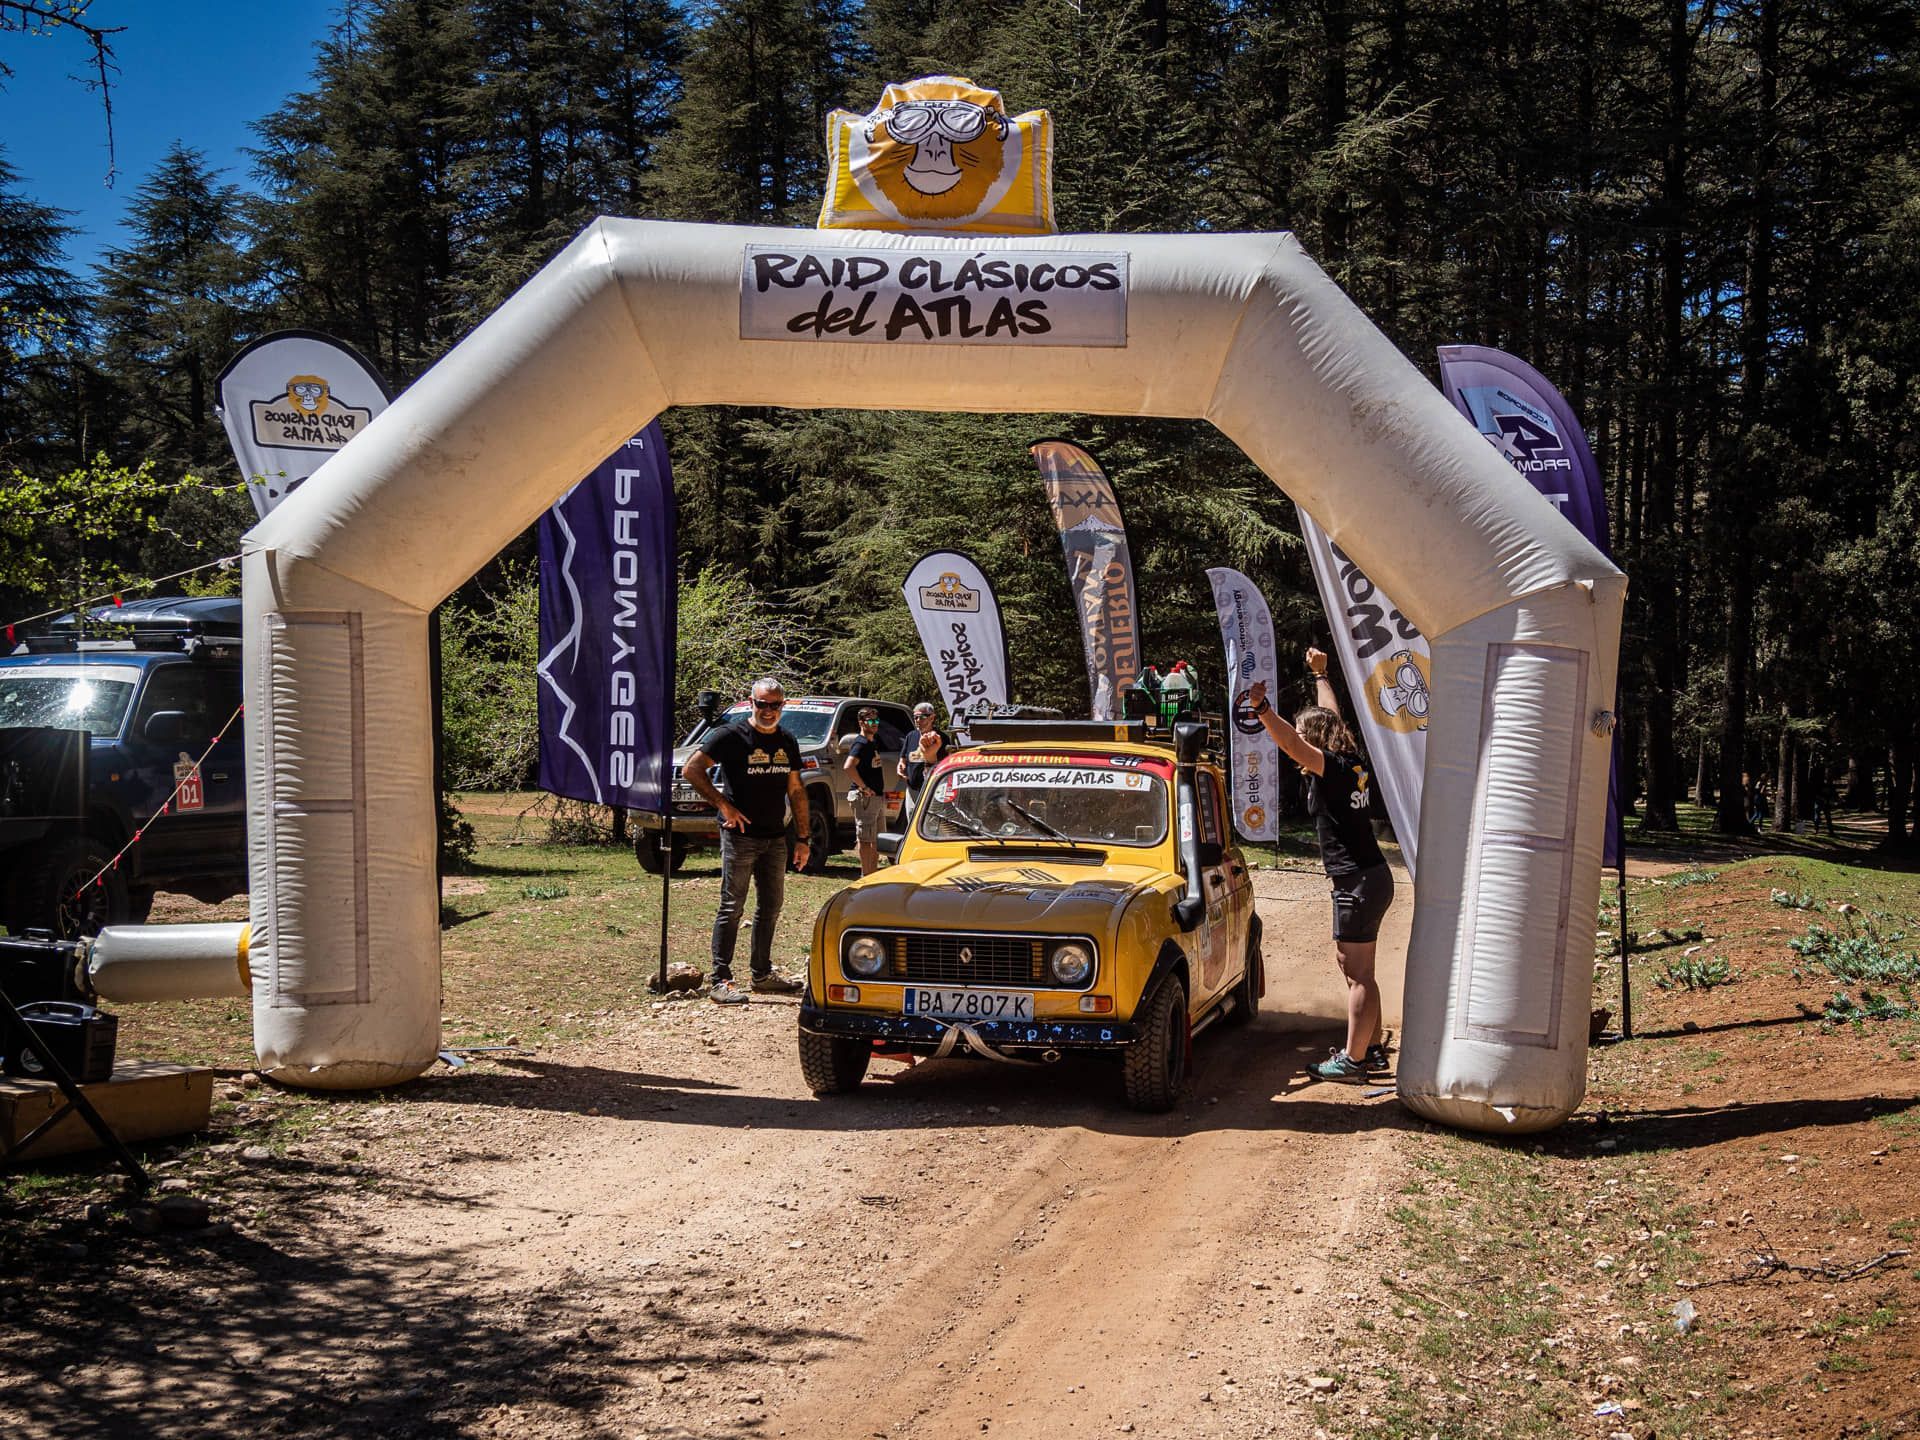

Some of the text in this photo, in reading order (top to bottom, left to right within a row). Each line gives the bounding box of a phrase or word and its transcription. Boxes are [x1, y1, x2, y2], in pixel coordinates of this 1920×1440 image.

[752, 251, 1122, 294] RAID CLÁSICOS
[786, 290, 1053, 341] del ATLAS
[1232, 588, 1244, 620] energy
[956, 768, 1115, 786] RAID CLÁSICOS del ATLAS
[1109, 755, 1145, 767] elf
[1244, 752, 1260, 803] eleksol
[919, 991, 943, 1013] BA
